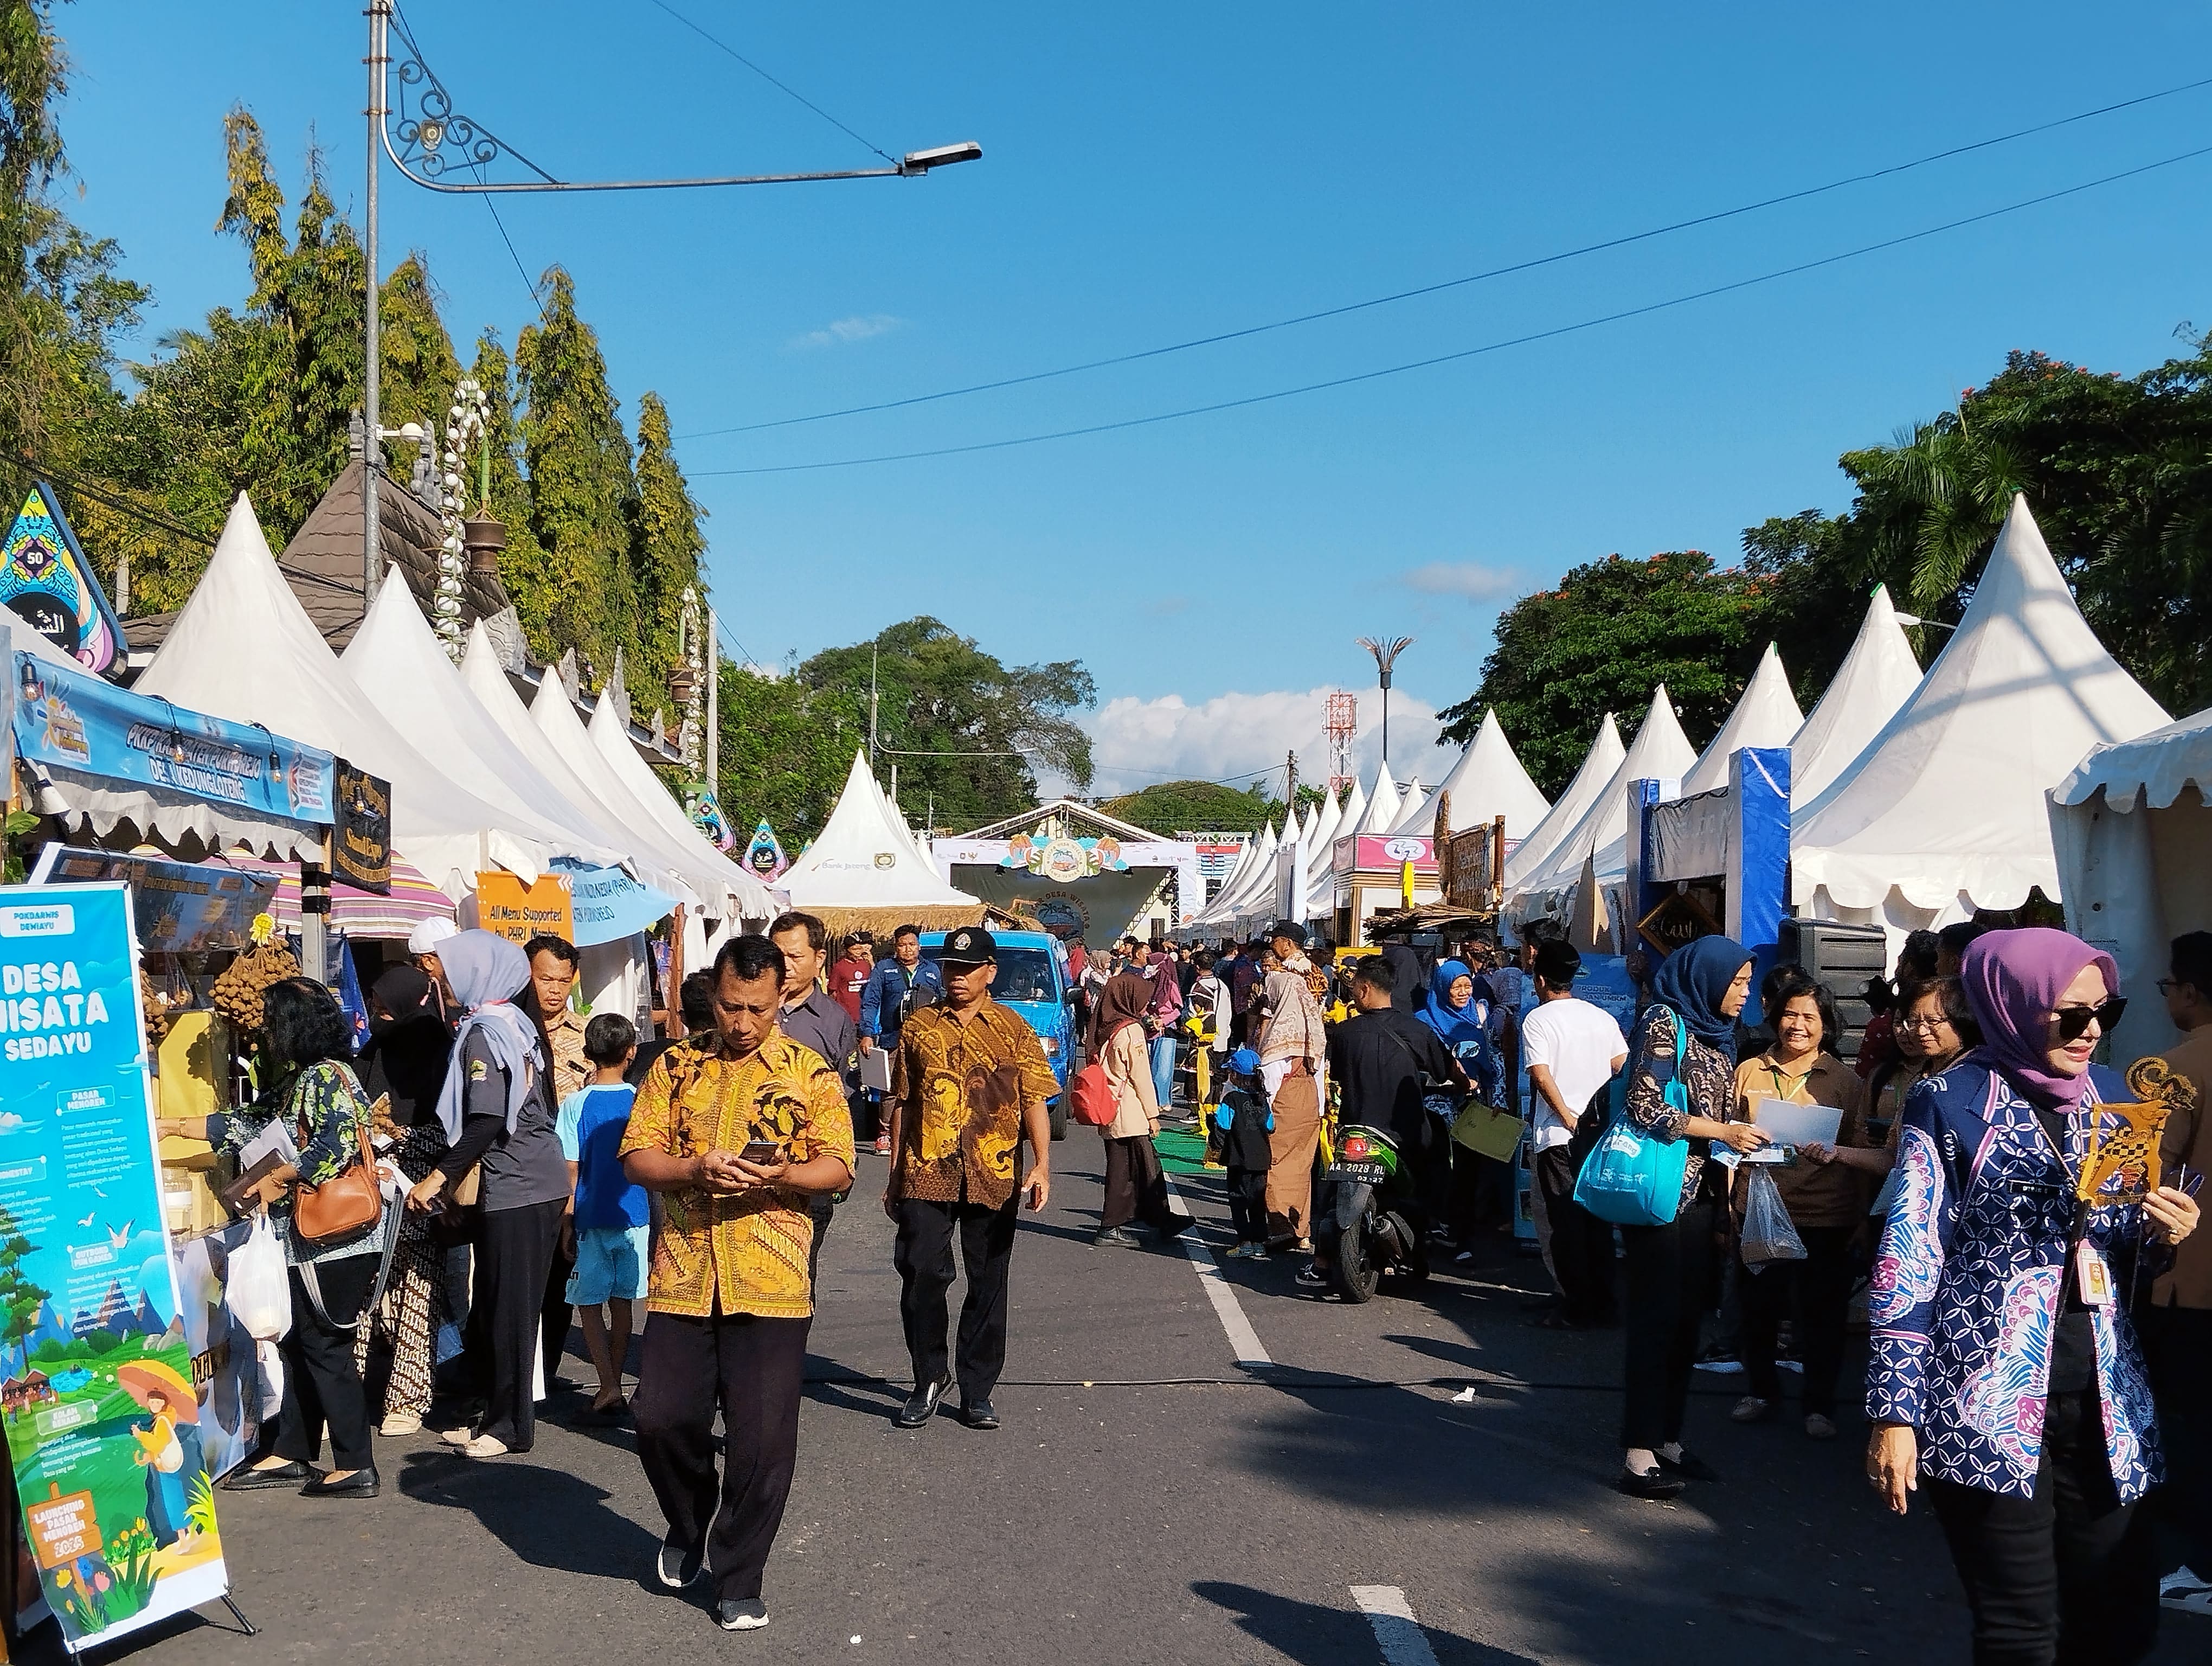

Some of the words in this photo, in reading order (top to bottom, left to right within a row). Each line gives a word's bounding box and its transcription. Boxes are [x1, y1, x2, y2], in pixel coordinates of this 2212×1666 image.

[27, 552, 43, 565] 50
[176, 763, 247, 803] KEDUNGLOTENG
[14, 911, 60, 920] POKDARWIS
[490, 906, 500, 920] All
[501, 906, 521, 920] Menu
[523, 906, 562, 924] Supported
[3, 961, 82, 995] DESA
[4, 1031, 92, 1061] SEDAYU
[67, 1097, 106, 1111] MENOREH
[72, 1089, 100, 1101] PASAR
[1346, 1163, 1370, 1173] 2028
[53, 1407, 78, 1420] KOLAM
[34, 1500, 85, 1524] LAUNCHING
[46, 1512, 78, 1530] PASAR
[43, 1519, 86, 1542] MENOREH
[54, 1535, 85, 1558] 2025
